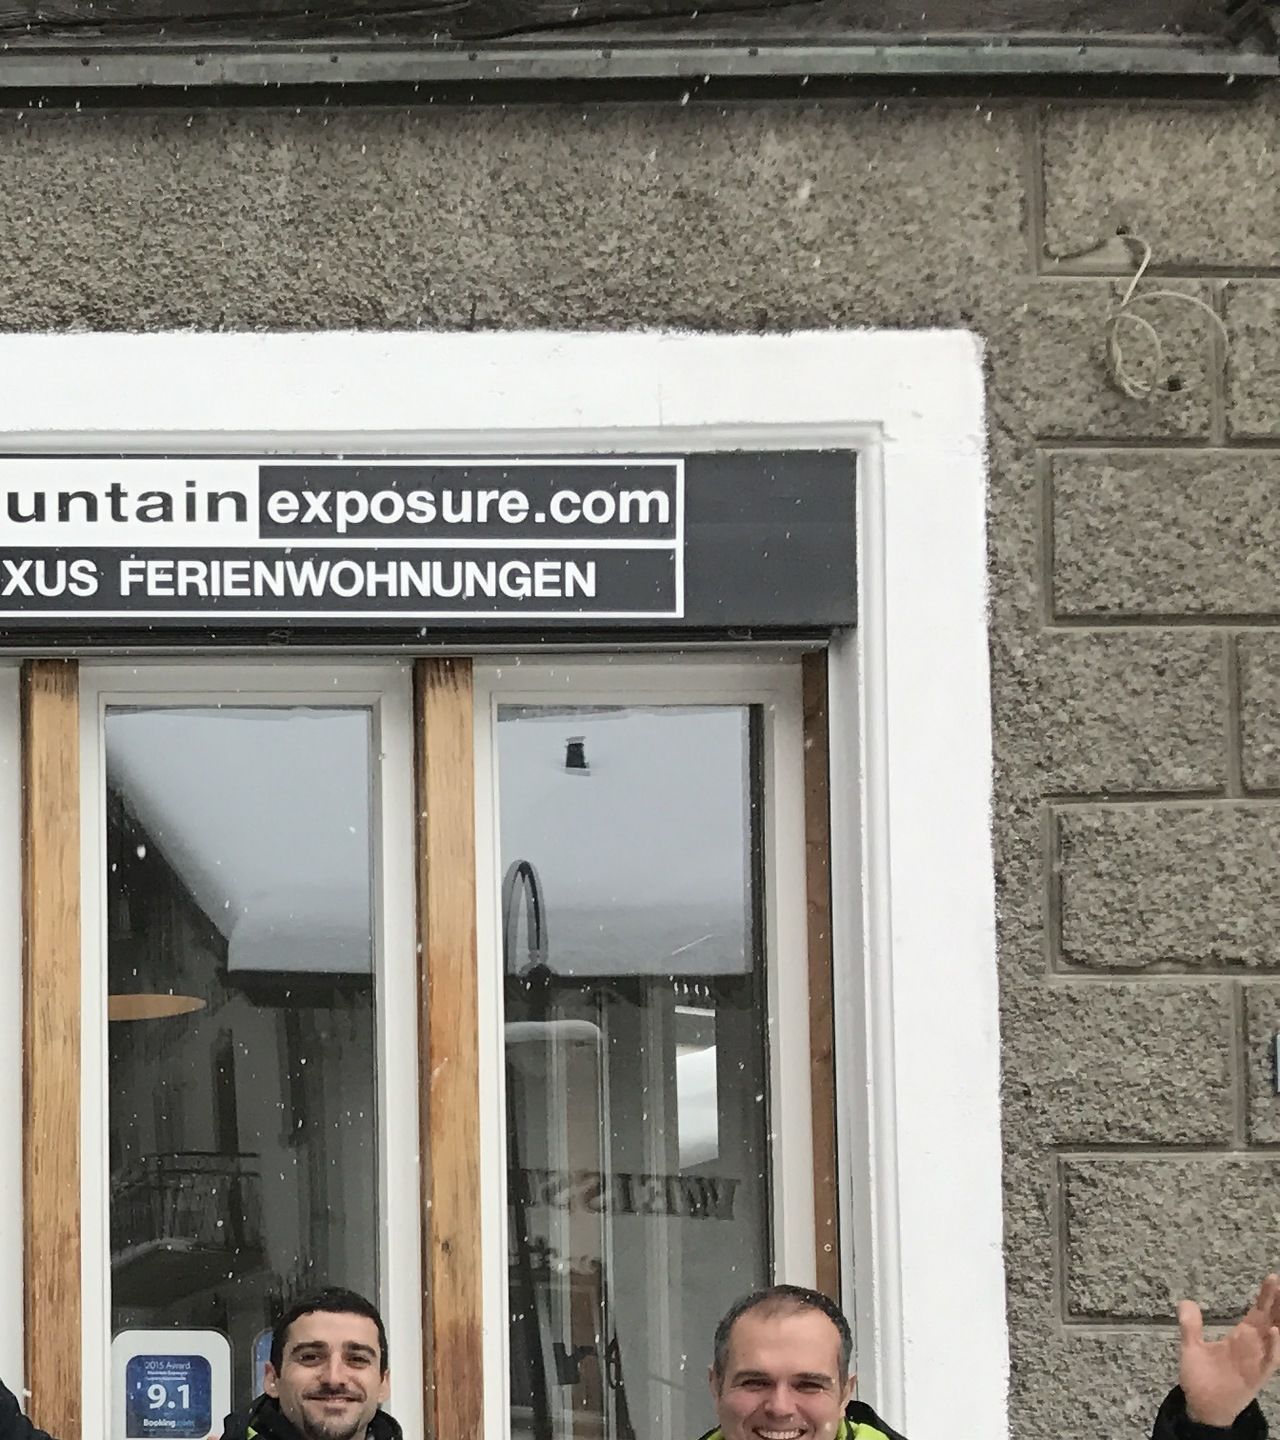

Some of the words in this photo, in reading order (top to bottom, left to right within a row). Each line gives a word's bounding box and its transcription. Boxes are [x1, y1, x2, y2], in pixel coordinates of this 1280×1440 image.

[266, 488, 671, 534] exposure.com
[120, 560, 597, 599] FERIENWOHNUNGEN
[147, 1383, 190, 1409] 9.1
